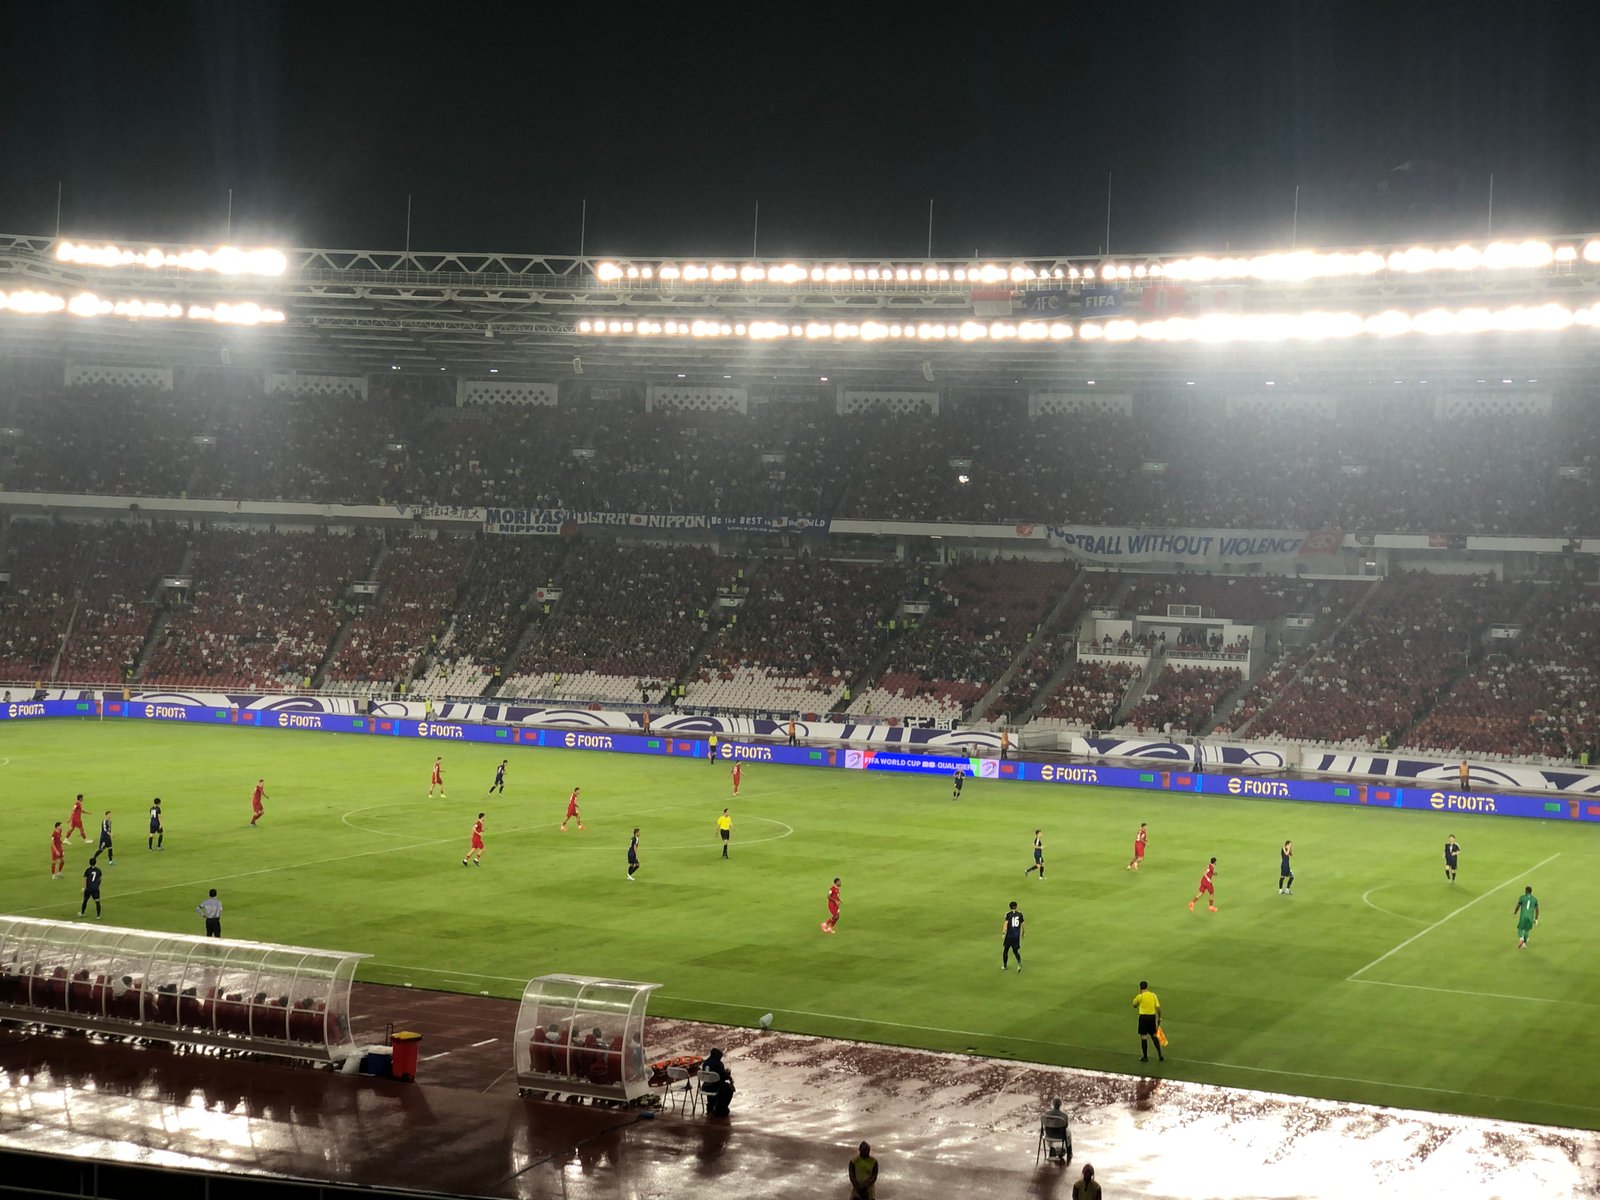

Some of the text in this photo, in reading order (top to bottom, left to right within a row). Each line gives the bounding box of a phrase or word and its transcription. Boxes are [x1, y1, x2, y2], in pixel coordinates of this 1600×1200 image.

[1085, 295, 1116, 308] FIFA
[648, 514, 706, 529] NIPPON
[499, 524, 558, 533] NIPPON
[1128, 535, 1213, 556] WITHOUT
[1219, 537, 1302, 556] VIOLENCE
[864, 756, 880, 765] FIFA
[880, 758, 906, 766] WORLD
[907, 759, 922, 768] CUP
[937, 762, 976, 771] QUALIIER
[91, 871, 97, 881] 7
[1011, 916, 1020, 927] 16
